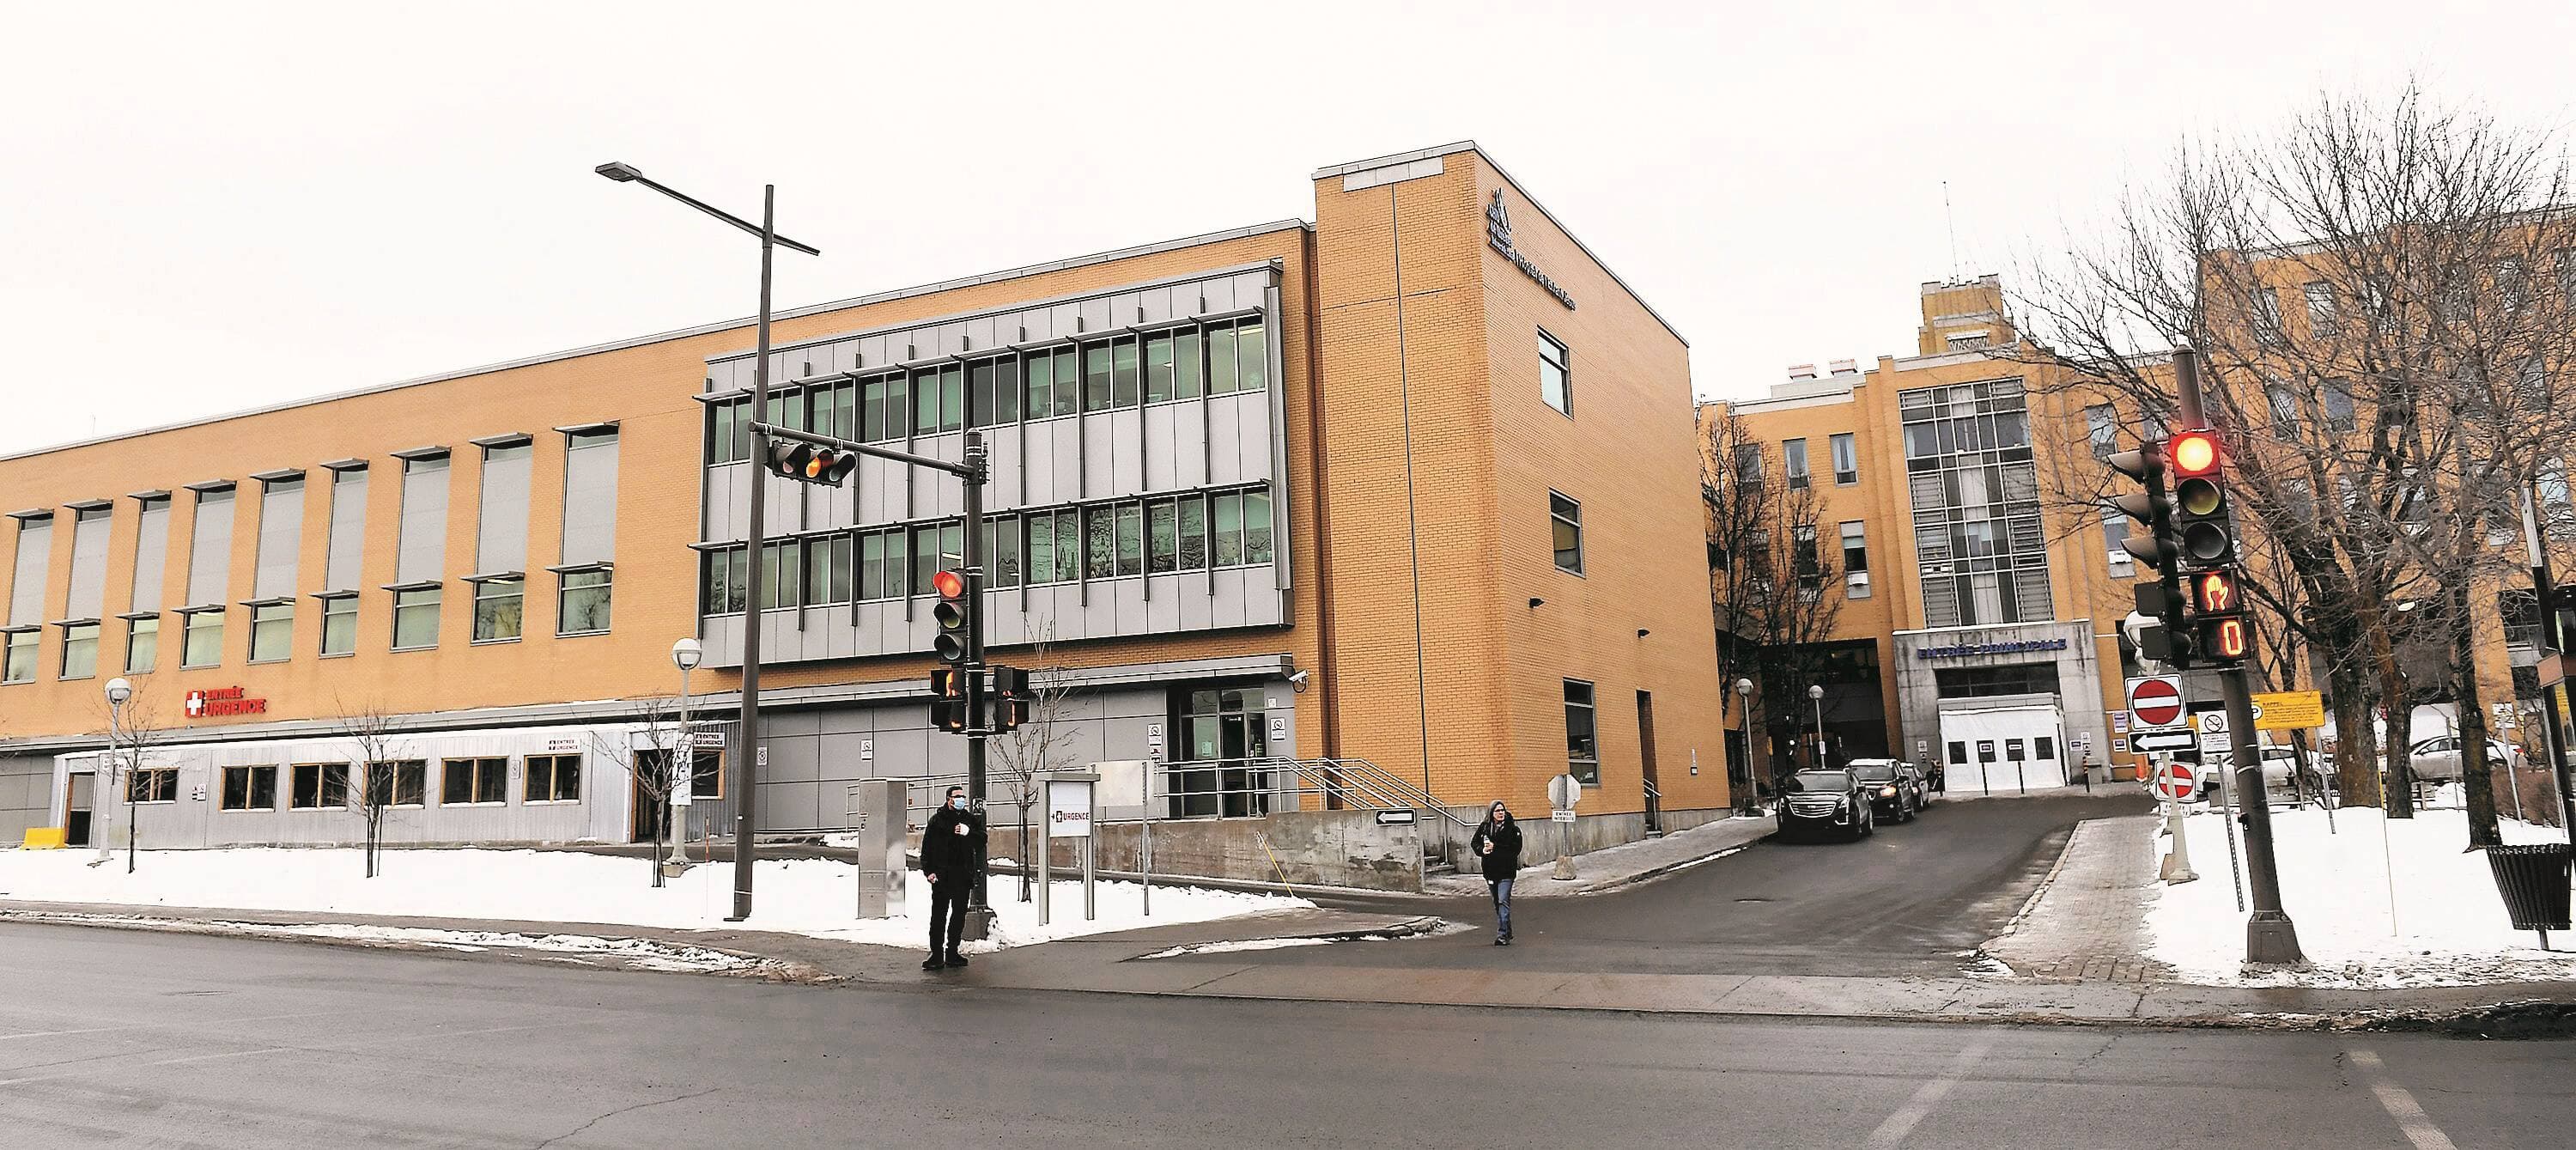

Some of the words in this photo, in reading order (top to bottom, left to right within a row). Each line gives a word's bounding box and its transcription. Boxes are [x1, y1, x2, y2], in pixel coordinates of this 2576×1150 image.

[2222, 620, 2244, 655] 0
[1917, 642, 1975, 660] ENTRÉE
[1978, 638, 2067, 654] PRINCIPALE
[206, 685, 244, 700] ENTRÉE
[205, 698, 267, 716] URGENCE
[1063, 812, 1090, 821] URGENCE
